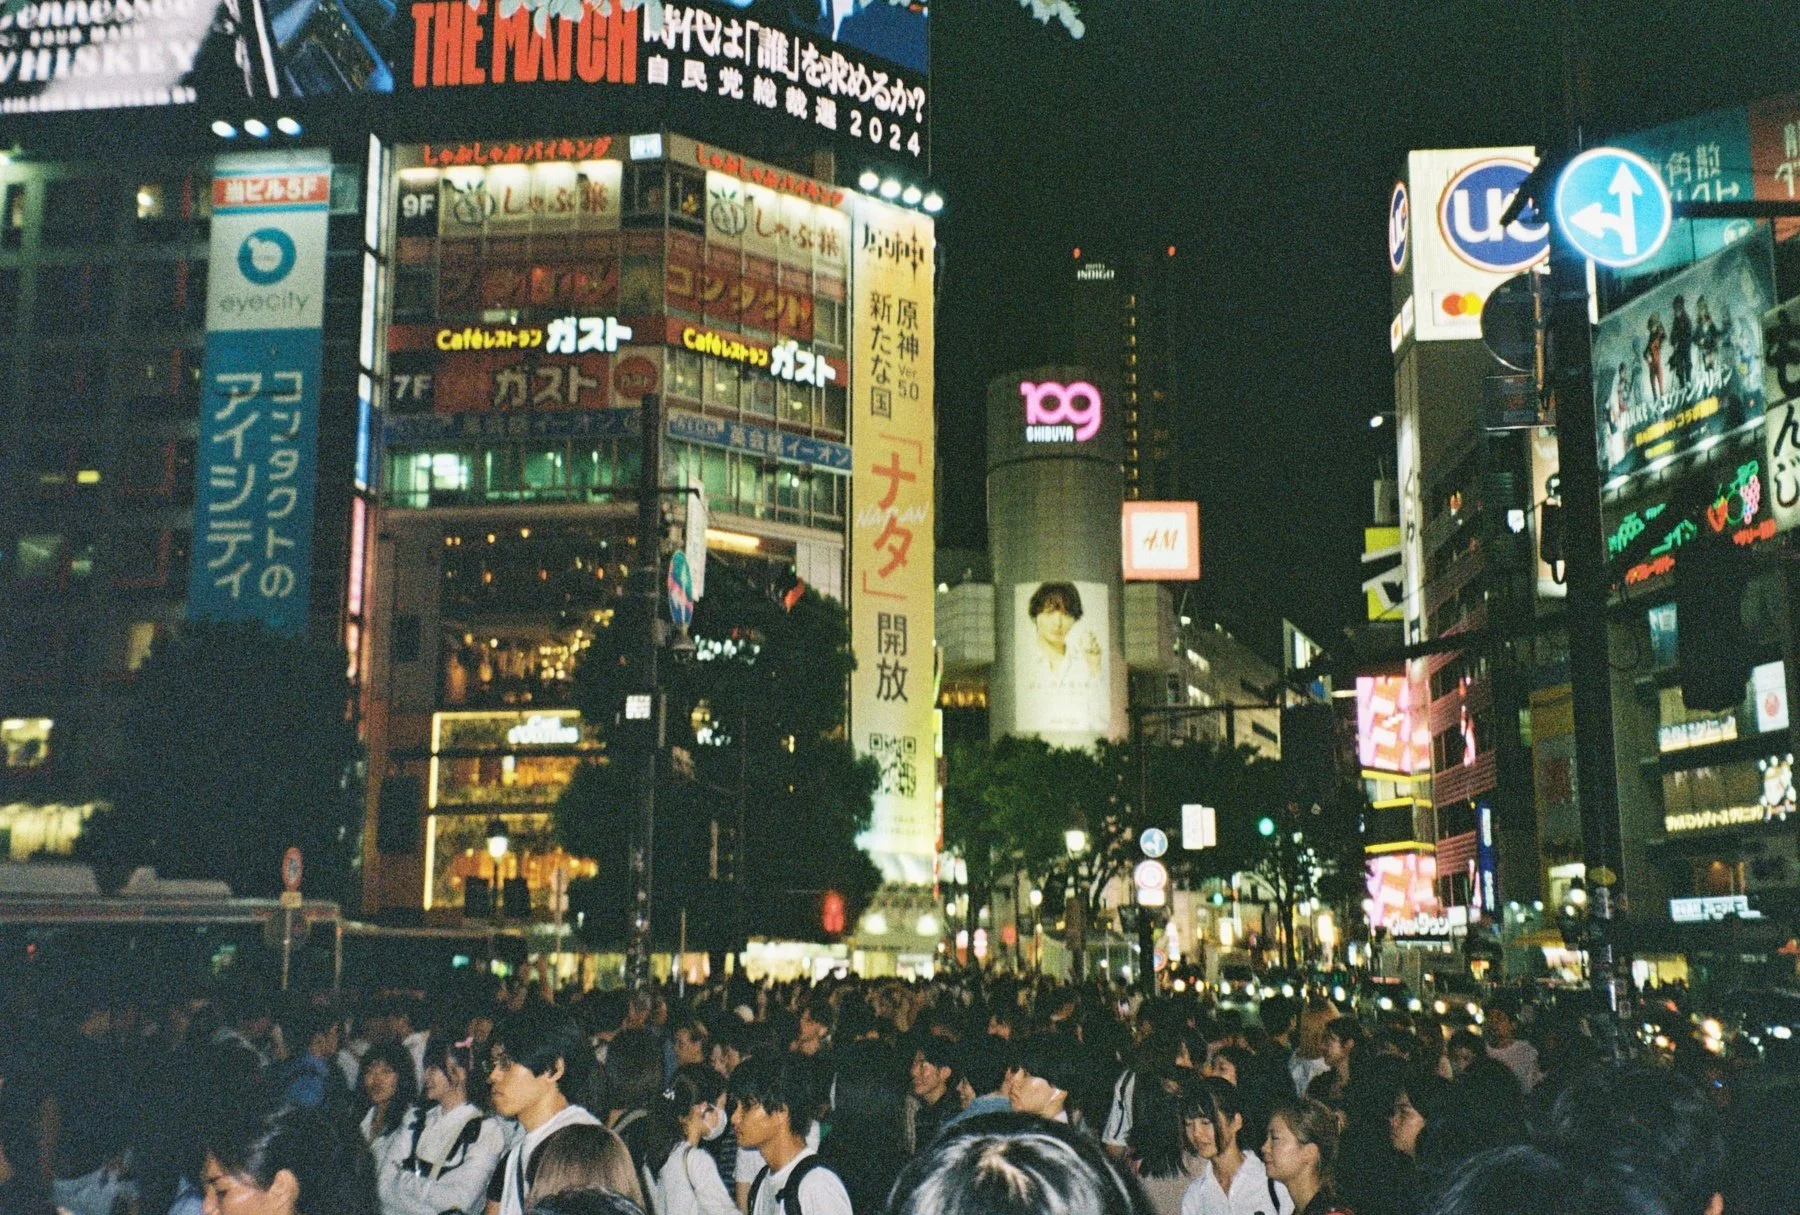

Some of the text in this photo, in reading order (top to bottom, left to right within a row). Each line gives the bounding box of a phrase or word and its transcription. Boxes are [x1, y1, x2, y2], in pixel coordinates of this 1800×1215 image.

[411, 0, 638, 87] THE MATCH
[647, 54, 921, 157] 自民党総裁選 2024
[402, 193, 435, 218] 9F
[219, 289, 309, 316] eyecity
[1077, 269, 1115, 280] INDIGO
[546, 315, 633, 353] ガスト
[870, 291, 892, 421] 新たな国
[897, 298, 919, 362] 原神
[393, 374, 432, 399] 7F
[494, 363, 600, 406] ガスト
[770, 339, 836, 388] ガスト
[1019, 381, 1103, 442] 109
[1025, 425, 1074, 442] SHIBUYA
[206, 371, 262, 599] アイシティ
[260, 371, 303, 599] コンタクトの
[862, 432, 924, 600] 「ナタ」
[876, 611, 909, 702] 開放
